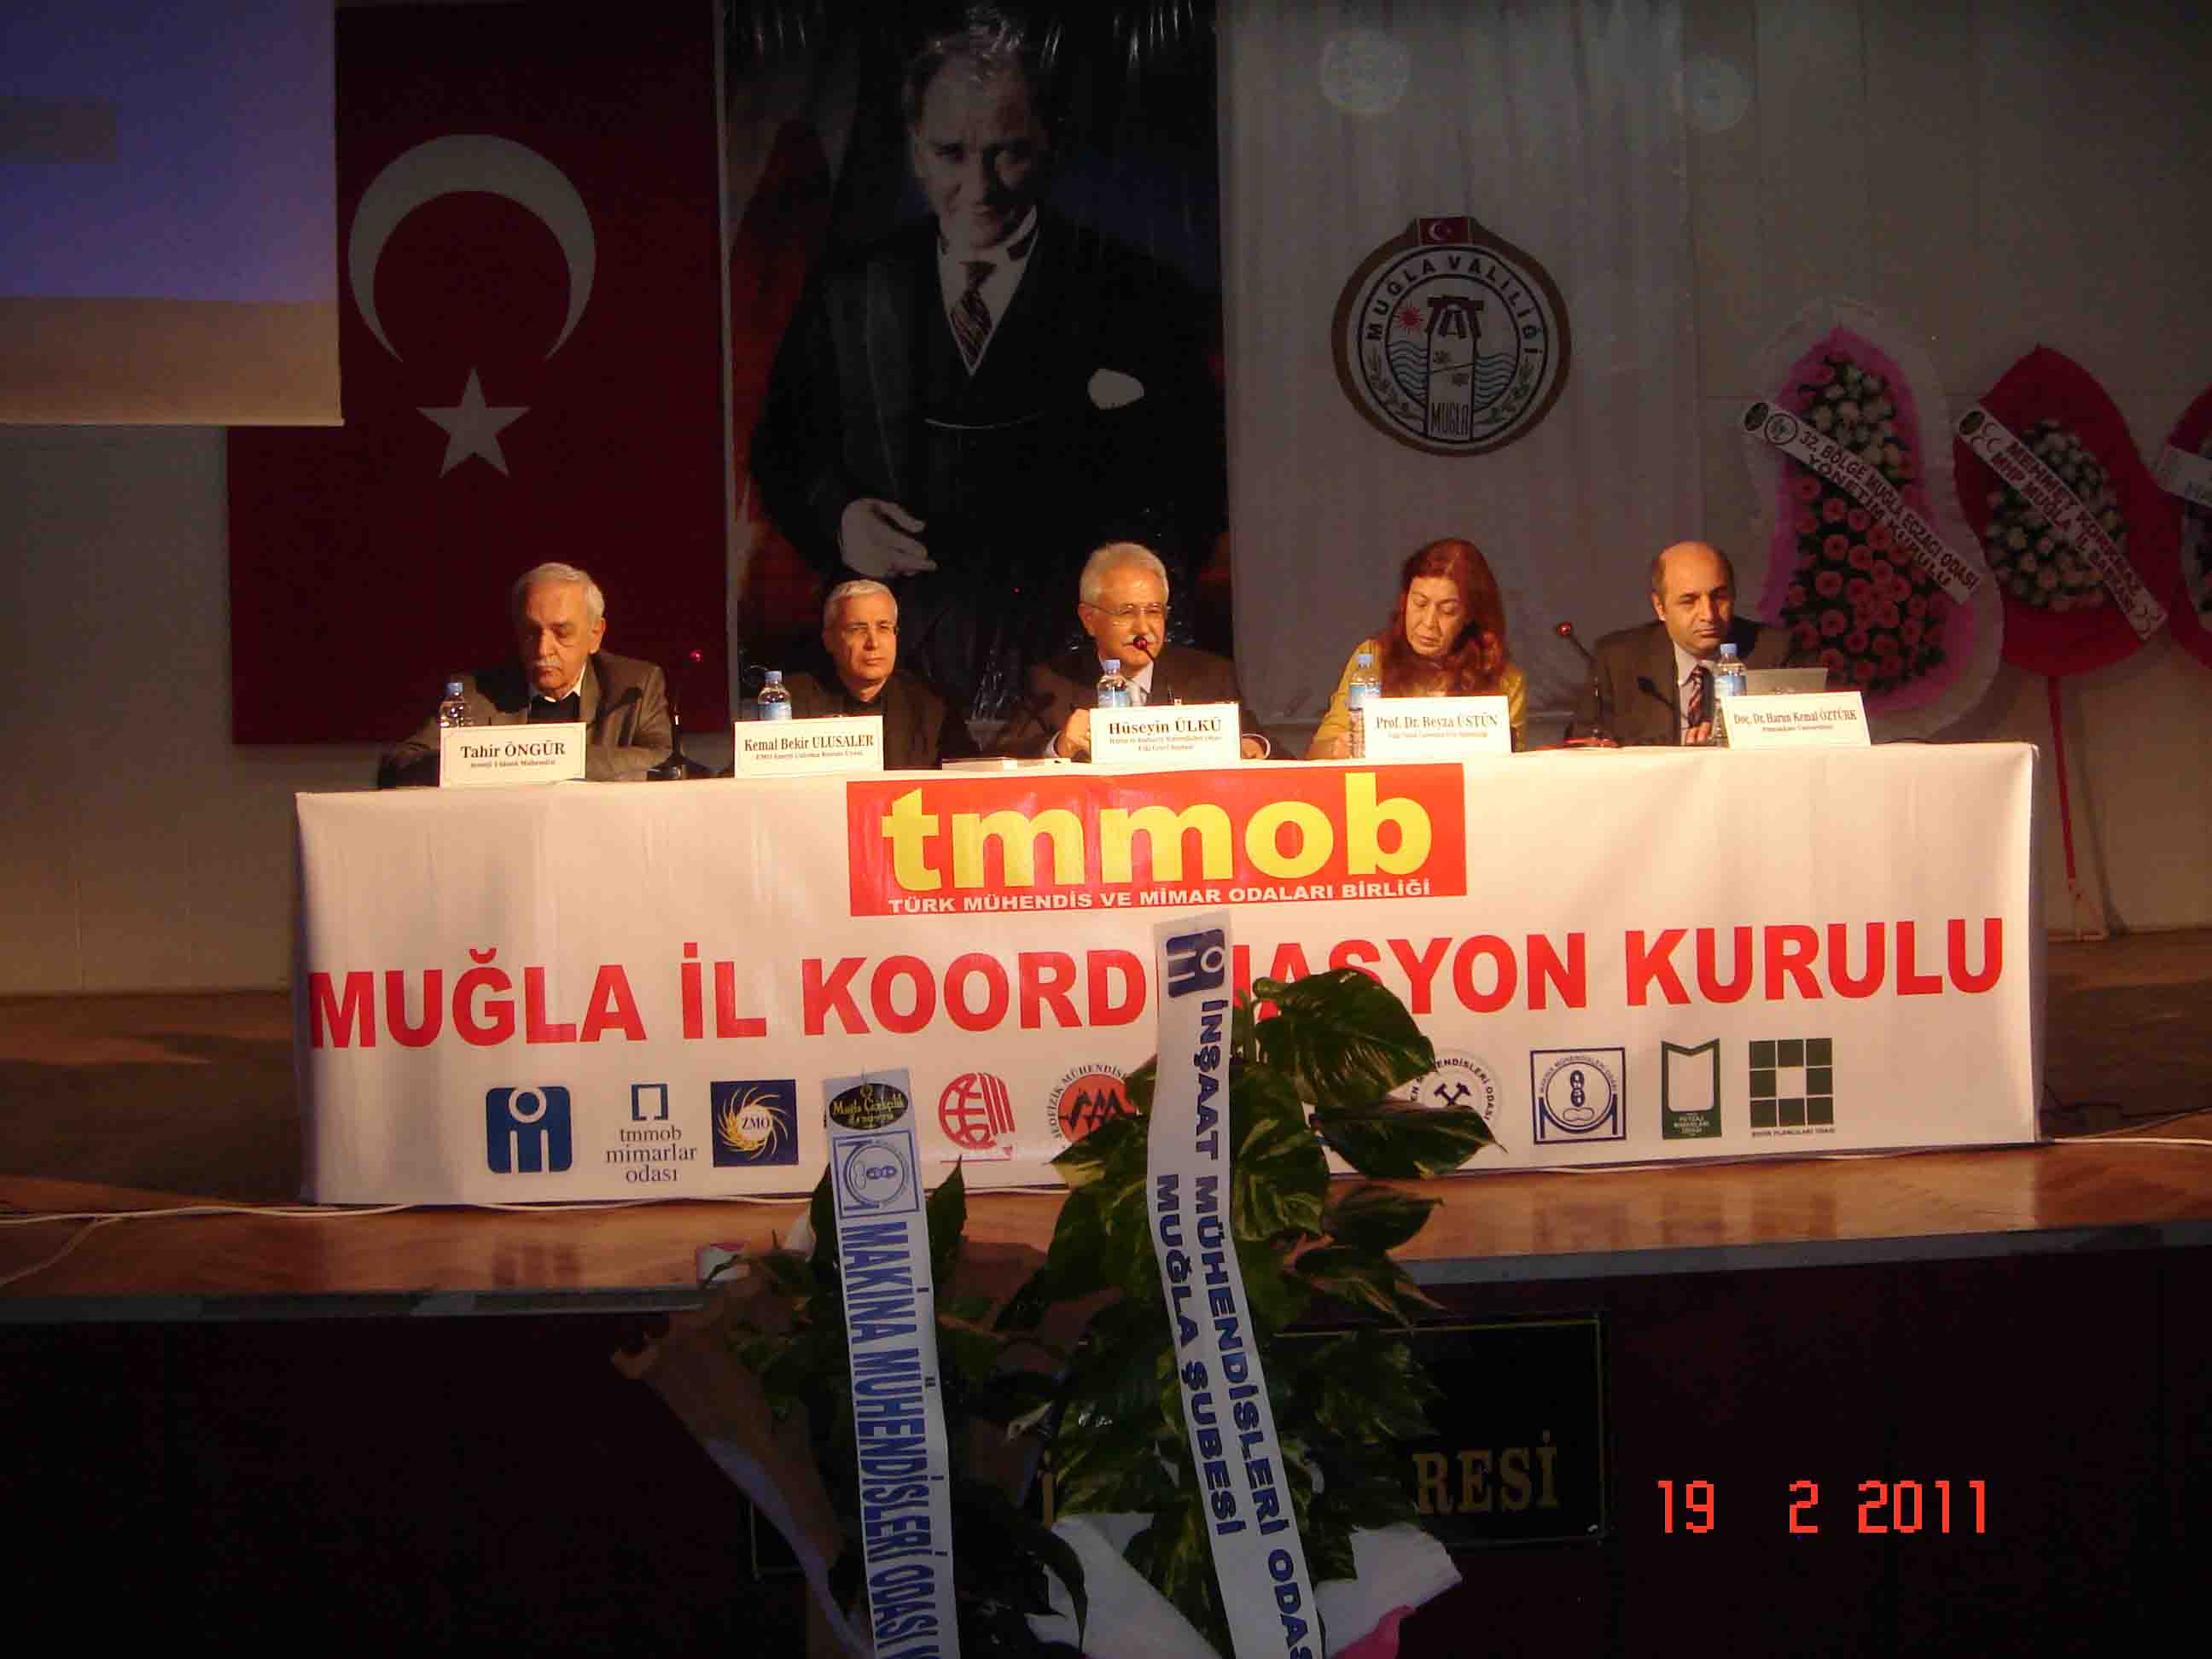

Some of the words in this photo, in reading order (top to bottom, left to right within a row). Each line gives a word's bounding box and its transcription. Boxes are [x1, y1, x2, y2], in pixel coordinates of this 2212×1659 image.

[1940, 551, 1980, 590] ODASI
[1109, 720, 1170, 736] Hüseyin
[1175, 717, 1222, 733] ÜLKÜ
[1376, 715, 1401, 730] Prof.
[1405, 715, 1419, 729] Dr.
[1423, 715, 1454, 731] Beyza
[1456, 712, 1499, 728] ÜSTÜN
[1767, 712, 1791, 725] Harun
[1793, 711, 1818, 723] Kemal
[1819, 707, 1857, 722] ÖZTÜRK
[459, 744, 500, 758] Tahir
[505, 740, 565, 757] ÖNGÜR
[744, 737, 778, 751] Kemal
[781, 736, 809, 750] Bekir
[812, 734, 875, 748] ULUSALER
[881, 771, 1432, 892] tmmob
[888, 896, 956, 915] TÜRK
[963, 891, 1093, 912] MÜHENDİS
[1099, 892, 1132, 909] VE
[1139, 887, 1223, 907] MİMAR
[1228, 885, 1335, 904] ODALARI
[1342, 879, 1431, 899] BİRLİĞİ
[308, 948, 647, 1048] MUĞLA
[681, 942, 767, 1039] İL
[801, 933, 1587, 1036] KOORDASYON
[1625, 918, 2003, 1006] KURULU
[1062, 1063, 1128, 1084] MÜHENDİSL
[1194, 999, 1229, 1161] İNŞAAT
[1484, 1086, 1495, 1121] ODASI
[620, 1126, 682, 1144] tmmob
[606, 1144, 697, 1165] mimarlar
[626, 1166, 678, 1184] odası
[841, 1221, 929, 1345] MAKİNA
[1157, 1173, 1199, 1348] MUĞLA
[1181, 1359, 1247, 1535] ŞUBESİ
[1196, 1175, 1290, 1536] MÜHENDİSLERİ
[853, 1348, 948, 1563] MÜHENDİSLERİ
[869, 1564, 939, 1650] ODASI
